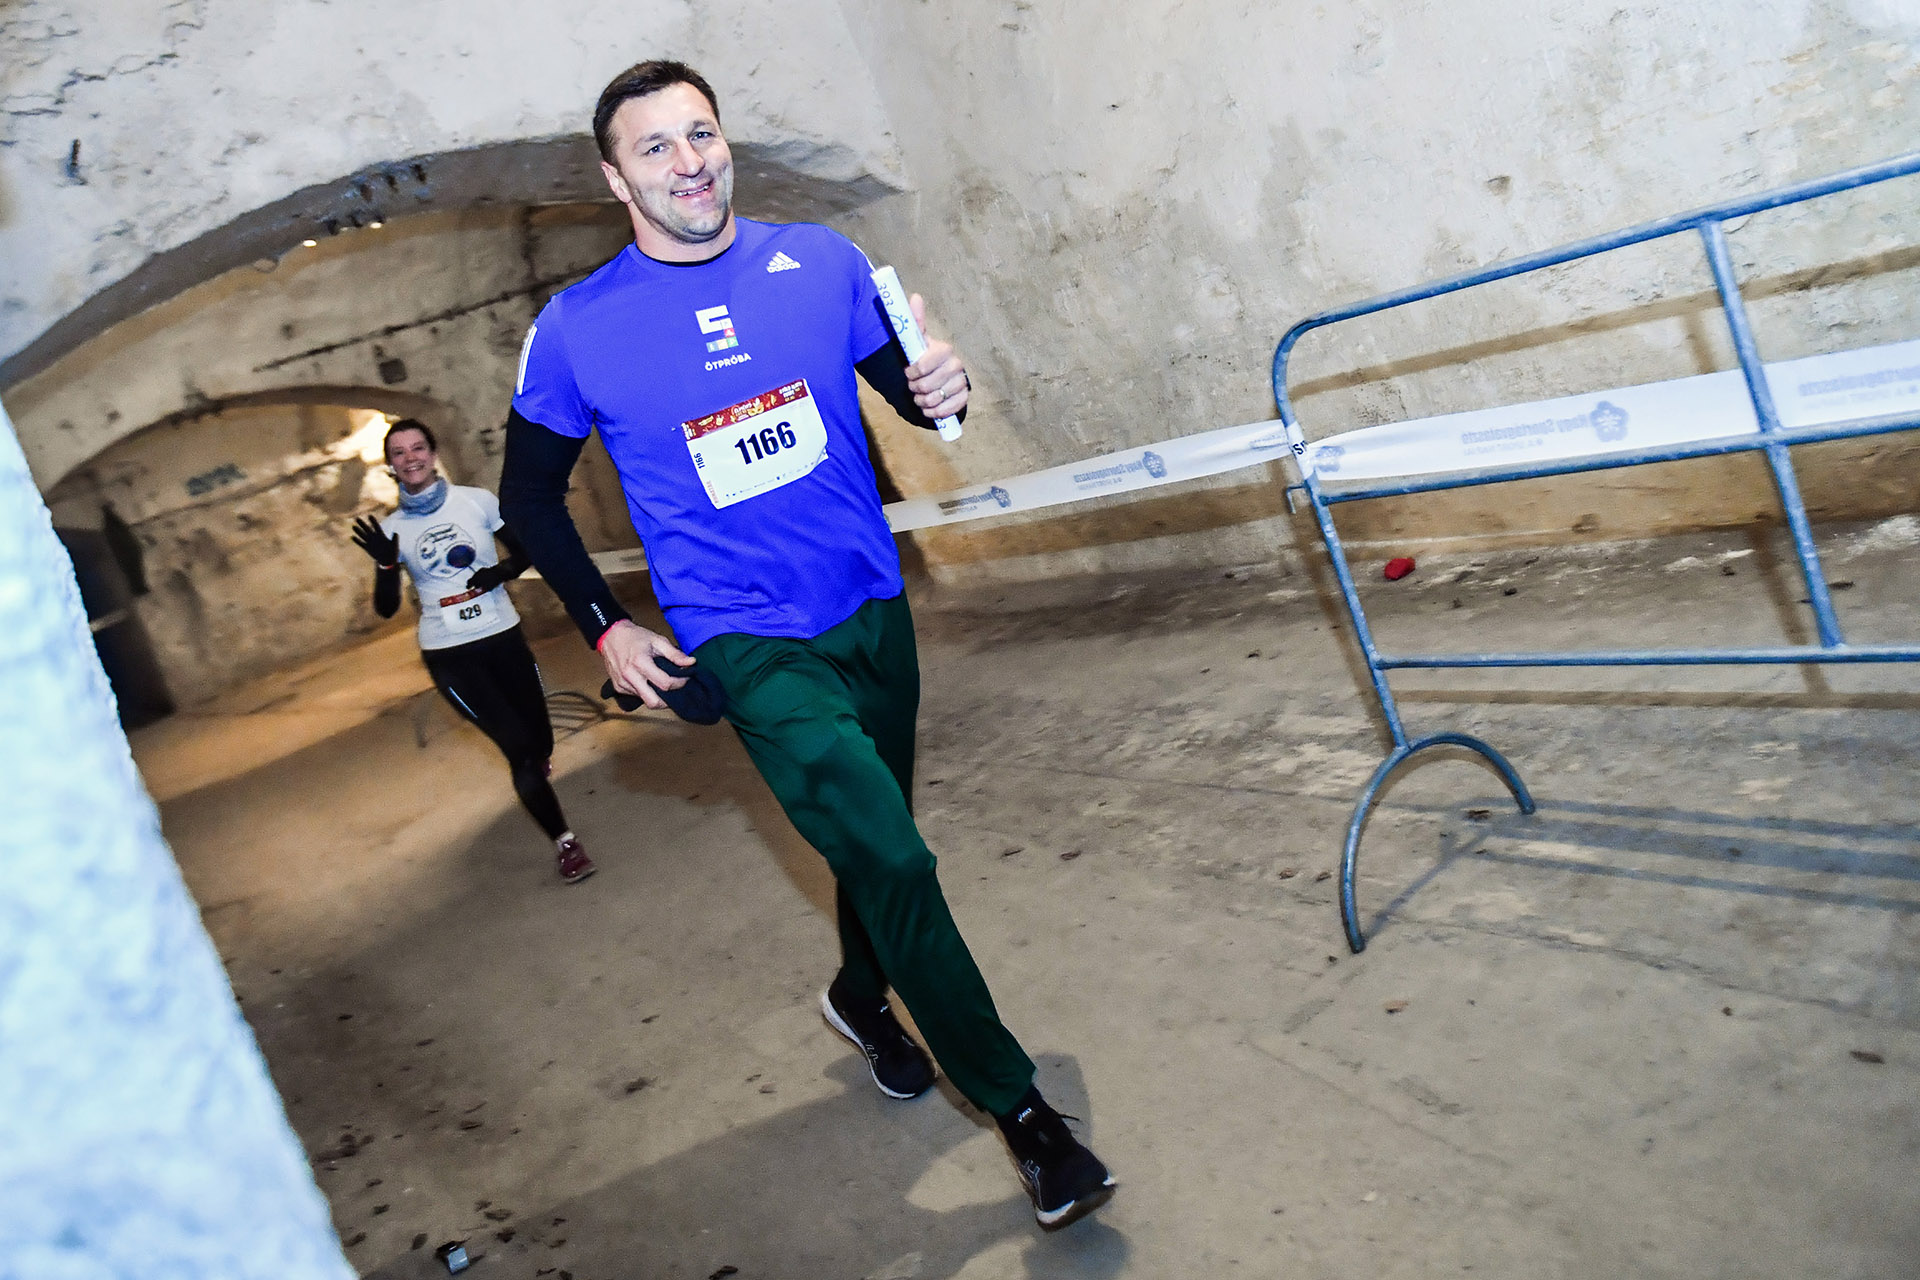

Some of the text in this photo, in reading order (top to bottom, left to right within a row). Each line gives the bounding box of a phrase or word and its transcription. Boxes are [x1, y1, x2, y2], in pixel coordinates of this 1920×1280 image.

[766, 261, 801, 273] adidas
[704, 352, 751, 371] ÖTPRÓBA
[734, 421, 797, 465] 1166
[693, 452, 705, 469] 1166
[459, 604, 482, 621] 429
